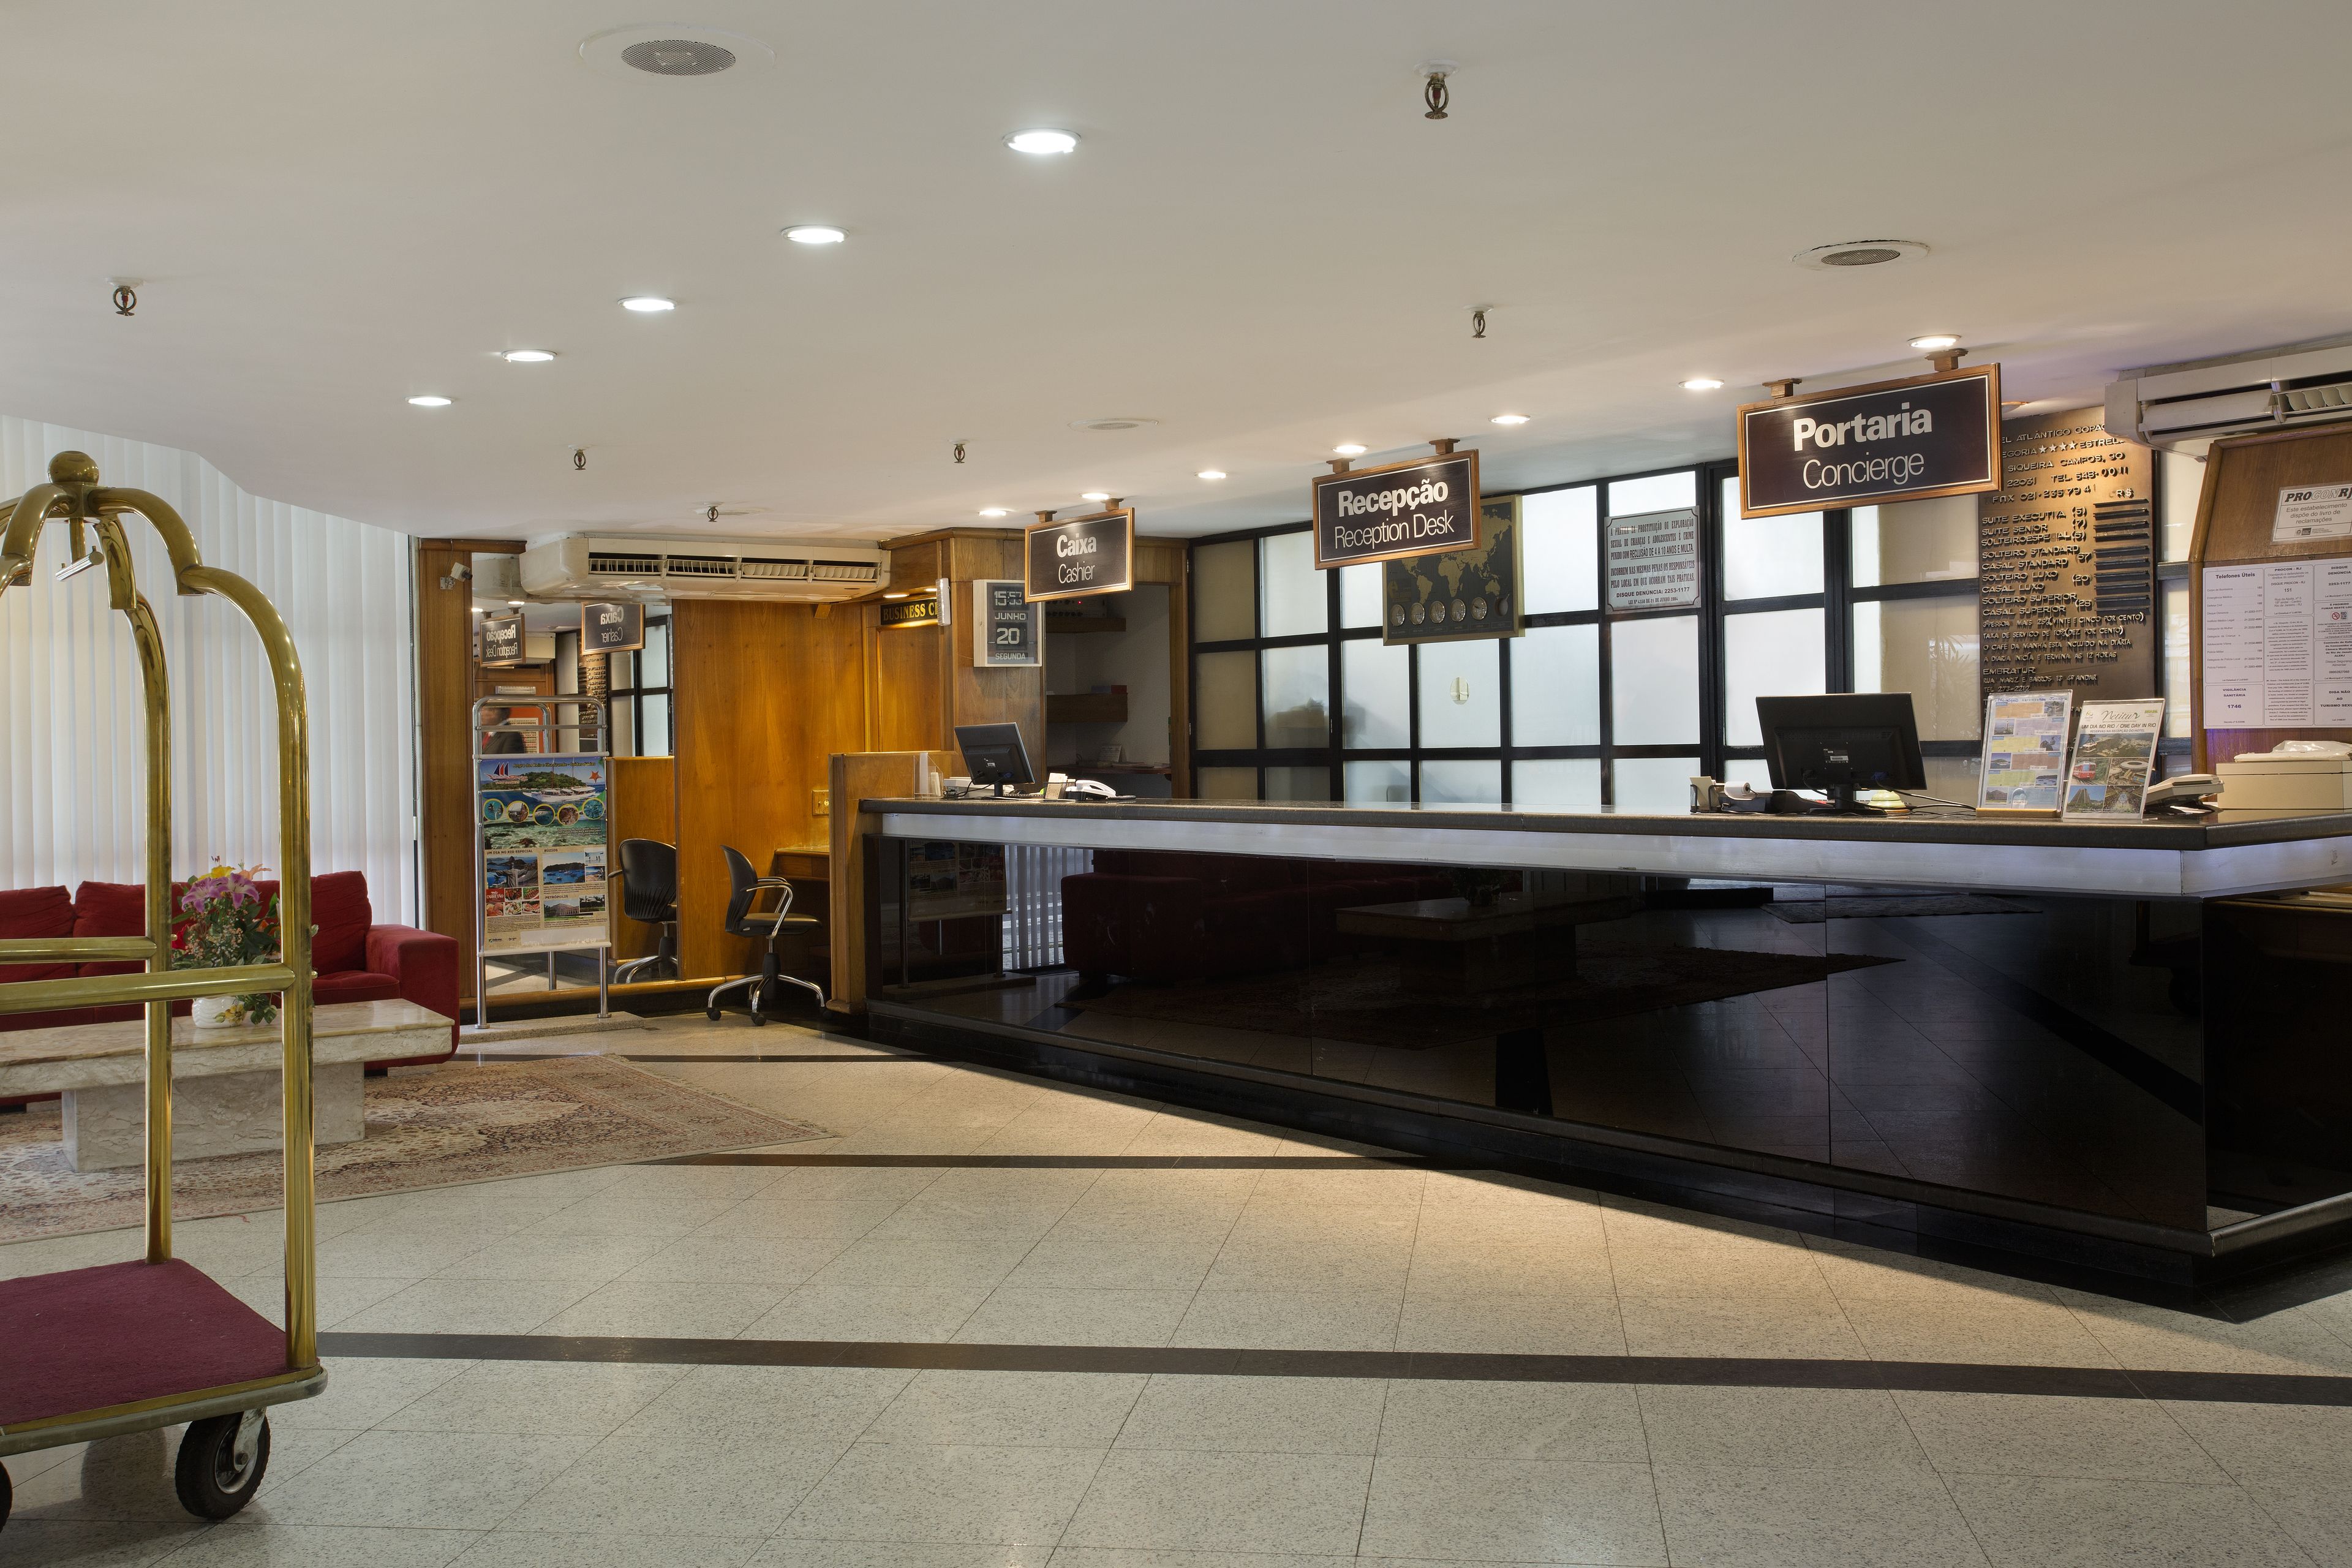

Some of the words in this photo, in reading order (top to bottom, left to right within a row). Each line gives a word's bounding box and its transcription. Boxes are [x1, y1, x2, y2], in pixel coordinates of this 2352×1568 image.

[1793, 402, 1932, 451] Portaria
[2016, 429, 2071, 442] ATLÂNTICO
[2008, 461, 2053, 472] SIQUEIRA
[2060, 454, 2106, 467] CAMPOS,
[1803, 452, 1924, 489] Concierge
[2007, 477, 2036, 487] 22031
[1338, 478, 1448, 517] Recepção
[2116, 489, 2133, 498] R$
[2301, 502, 2347, 511] estabelecimento
[1638, 521, 1662, 533] PROSTITUIÇÃO
[1665, 521, 1669, 530] OU
[1671, 517, 1694, 529] EXPLORAÇÃO
[1982, 516, 2008, 524] SUITE
[1335, 518, 1409, 549] Reception
[1413, 510, 1455, 538] Desk
[1982, 527, 2009, 535] SUITE
[2013, 523, 2048, 533] SENIOR
[1057, 533, 1097, 557] Caixa
[1611, 539, 1622, 548] SEXUAL
[1624, 538, 1629, 546] DE
[1630, 535, 1645, 547] CRIANÇAS
[1653, 533, 1676, 544] ADOLESCENTES
[1683, 530, 1694, 540] CRIME
[1611, 551, 1623, 560] PUNIDO
[1629, 546, 1648, 559] RECLUSÃO
[1649, 548, 1654, 556] DE
[1654, 547, 1657, 556] 4
[1657, 546, 1661, 555] A
[1661, 546, 1666, 555] 10
[1666, 545, 1677, 554] ANOS
[1677, 545, 1681, 554] E
[1681, 543, 1694, 552] MULTA.
[1982, 549, 2026, 559] SOLTEIRO
[2030, 544, 2079, 555] STANDARD
[1611, 567, 1628, 576] INCORREM
[1637, 564, 1651, 574] MESMAS
[1651, 563, 1663, 572] PENAS
[1663, 562, 1668, 571] OS
[1668, 559, 1695, 571] RESPONSÁVEIS
[2018, 557, 2068, 568] STANDARD
[1058, 560, 1095, 584] Cashier
[1982, 572, 2027, 581] SOLTEIRO
[1621, 579, 1632, 588] LOCAL
[1633, 578, 1639, 587] EM
[1649, 576, 1666, 586] OCORRAM
[1981, 584, 2015, 593] CASAL
[1982, 596, 2026, 605] SOLTEIRO
[2030, 593, 2078, 601] SUPERIOR
[883, 603, 926, 621] BUSINESS
[2019, 605, 2067, 614] SUPERIOR
[2118, 611, 2144, 621] CENTO)
[997, 627, 1020, 644] 20
[2099, 625, 2124, 635] CENTO)
[1983, 666, 2036, 675] EMBRATUR
